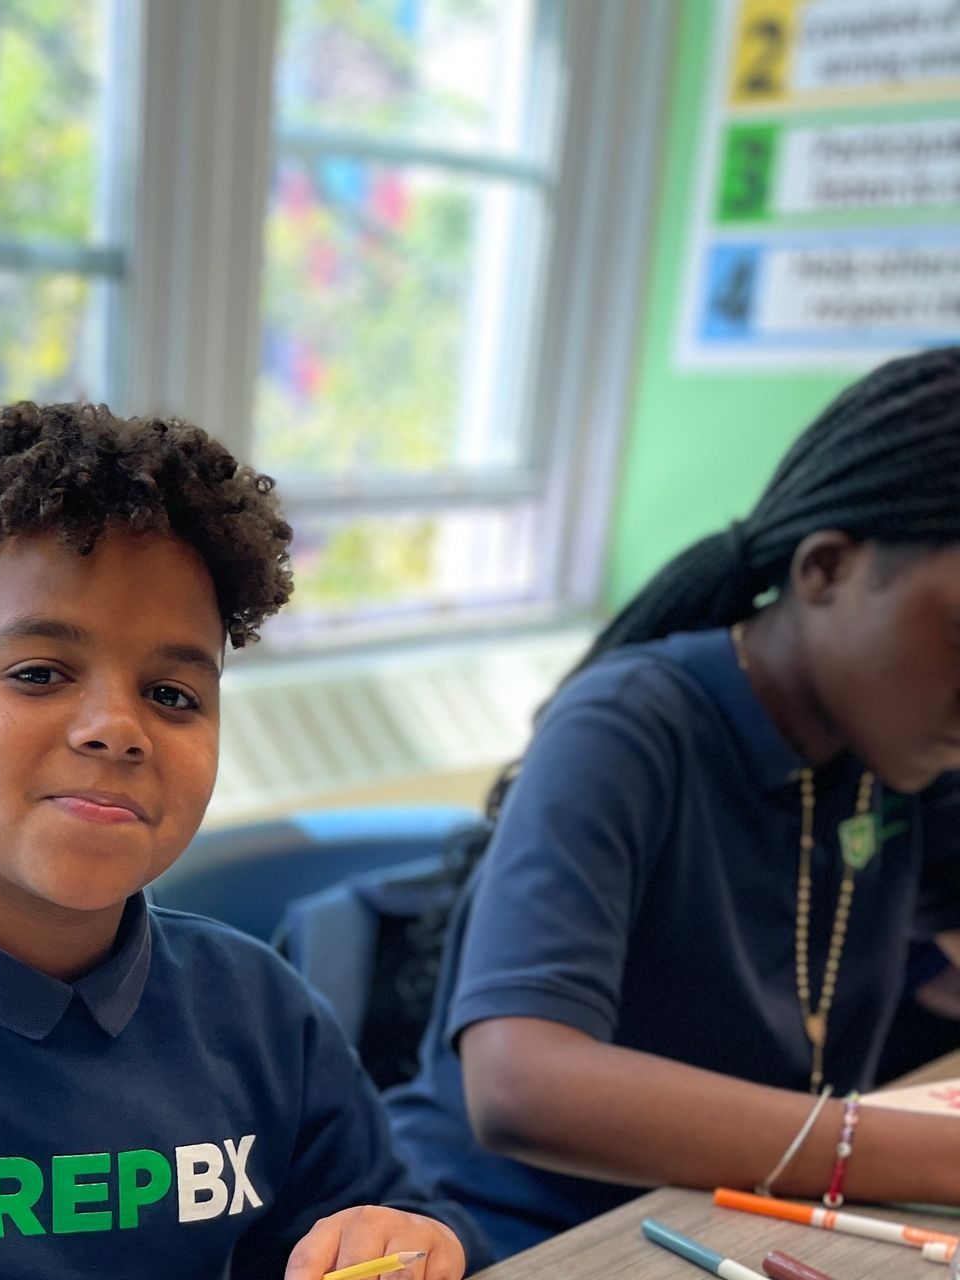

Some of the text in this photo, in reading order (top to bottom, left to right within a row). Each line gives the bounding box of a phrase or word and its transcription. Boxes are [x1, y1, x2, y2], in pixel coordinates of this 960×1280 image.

[743, 20, 783, 95] 2
[732, 136, 769, 216] 3
[710, 254, 754, 324] 4
